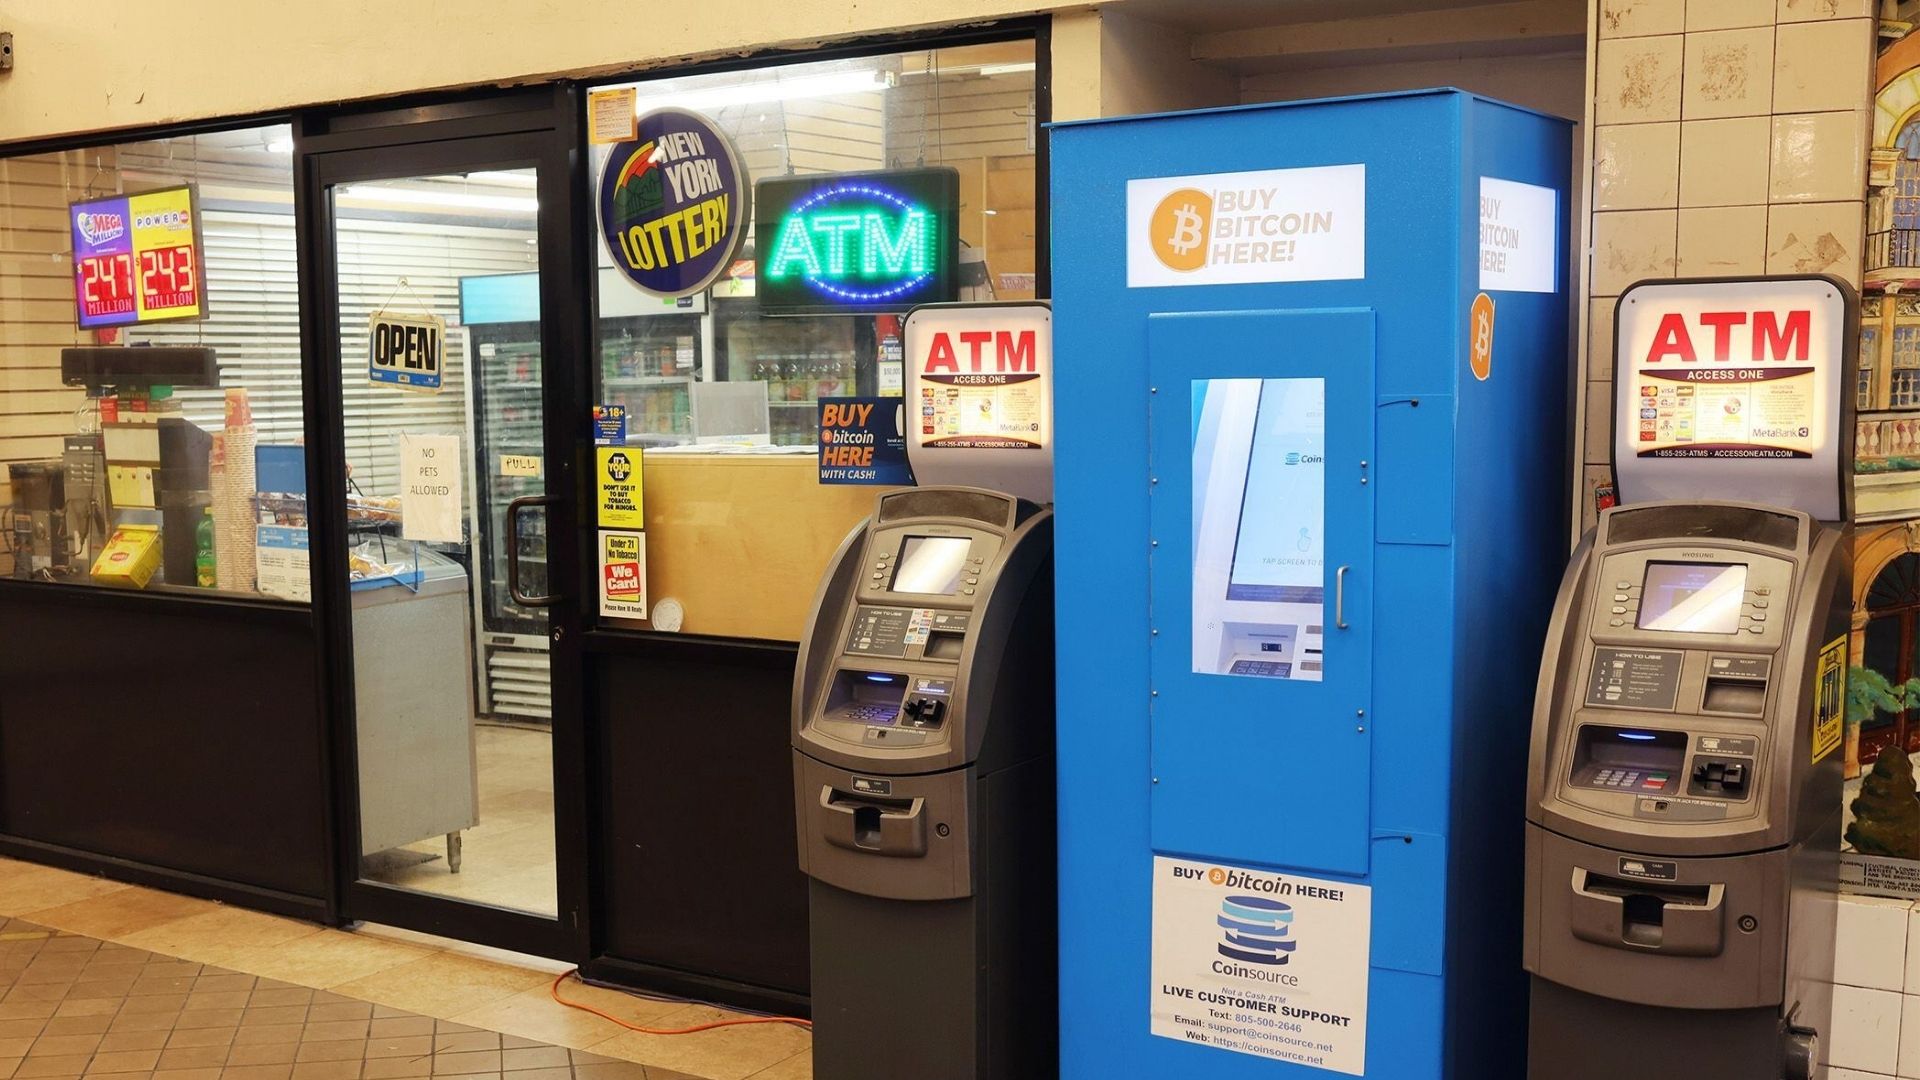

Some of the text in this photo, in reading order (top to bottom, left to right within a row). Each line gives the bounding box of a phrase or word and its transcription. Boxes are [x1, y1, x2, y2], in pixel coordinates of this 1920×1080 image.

[658, 132, 705, 164] NEW
[665, 158, 723, 204] YORK
[1217, 188, 1278, 213] BUY
[1480, 196, 1501, 220] BUY
[93, 214, 122, 234] MEGA
[617, 193, 728, 271] LOTTERY
[1214, 211, 1334, 239] BITCOIN
[768, 211, 937, 278] ATM
[1480, 222, 1519, 249] BITCOIN
[1212, 240, 1296, 266] HERE!
[88, 298, 133, 315] MILLION
[146, 292, 193, 309] MILLION
[375, 322, 436, 370] OPEN
[1646, 310, 1811, 362] ATM
[924, 330, 1036, 373] ATM
[954, 376, 1006, 384] ACCESS ONE
[1687, 369, 1764, 380] ACCESS ONE
[822, 404, 874, 428] BUY
[832, 430, 874, 444] bitcoin
[1000, 423, 1030, 432] MetaBank
[1752, 428, 1798, 438] MetaBank
[422, 448, 435, 458] NO
[822, 446, 874, 466] HERE
[420, 467, 438, 477] PETS
[608, 463, 630, 472] YOUR
[821, 470, 876, 480] WITH CASH!
[410, 486, 449, 496] ALLOWED
[608, 549, 637, 560] No Tobacco
[610, 539, 626, 548] Under
[611, 565, 633, 577] We
[608, 576, 638, 590] Card
[1174, 866, 1343, 902] BUY bitcoin HERE!
[1212, 960, 1298, 986] Coinsource
[1163, 984, 1350, 1027] LIVE CUSTOMER SUPPORT
[1221, 987, 1236, 996] Not
[1245, 990, 1266, 1000] Cash
[1268, 995, 1286, 1004] ATM
[1208, 1008, 1302, 1033] Text: 805-500-2646
[1174, 1015, 1334, 1053] Email: support@coinsource.net
[1186, 1030, 1324, 1065] Web: https://coinsource.net
